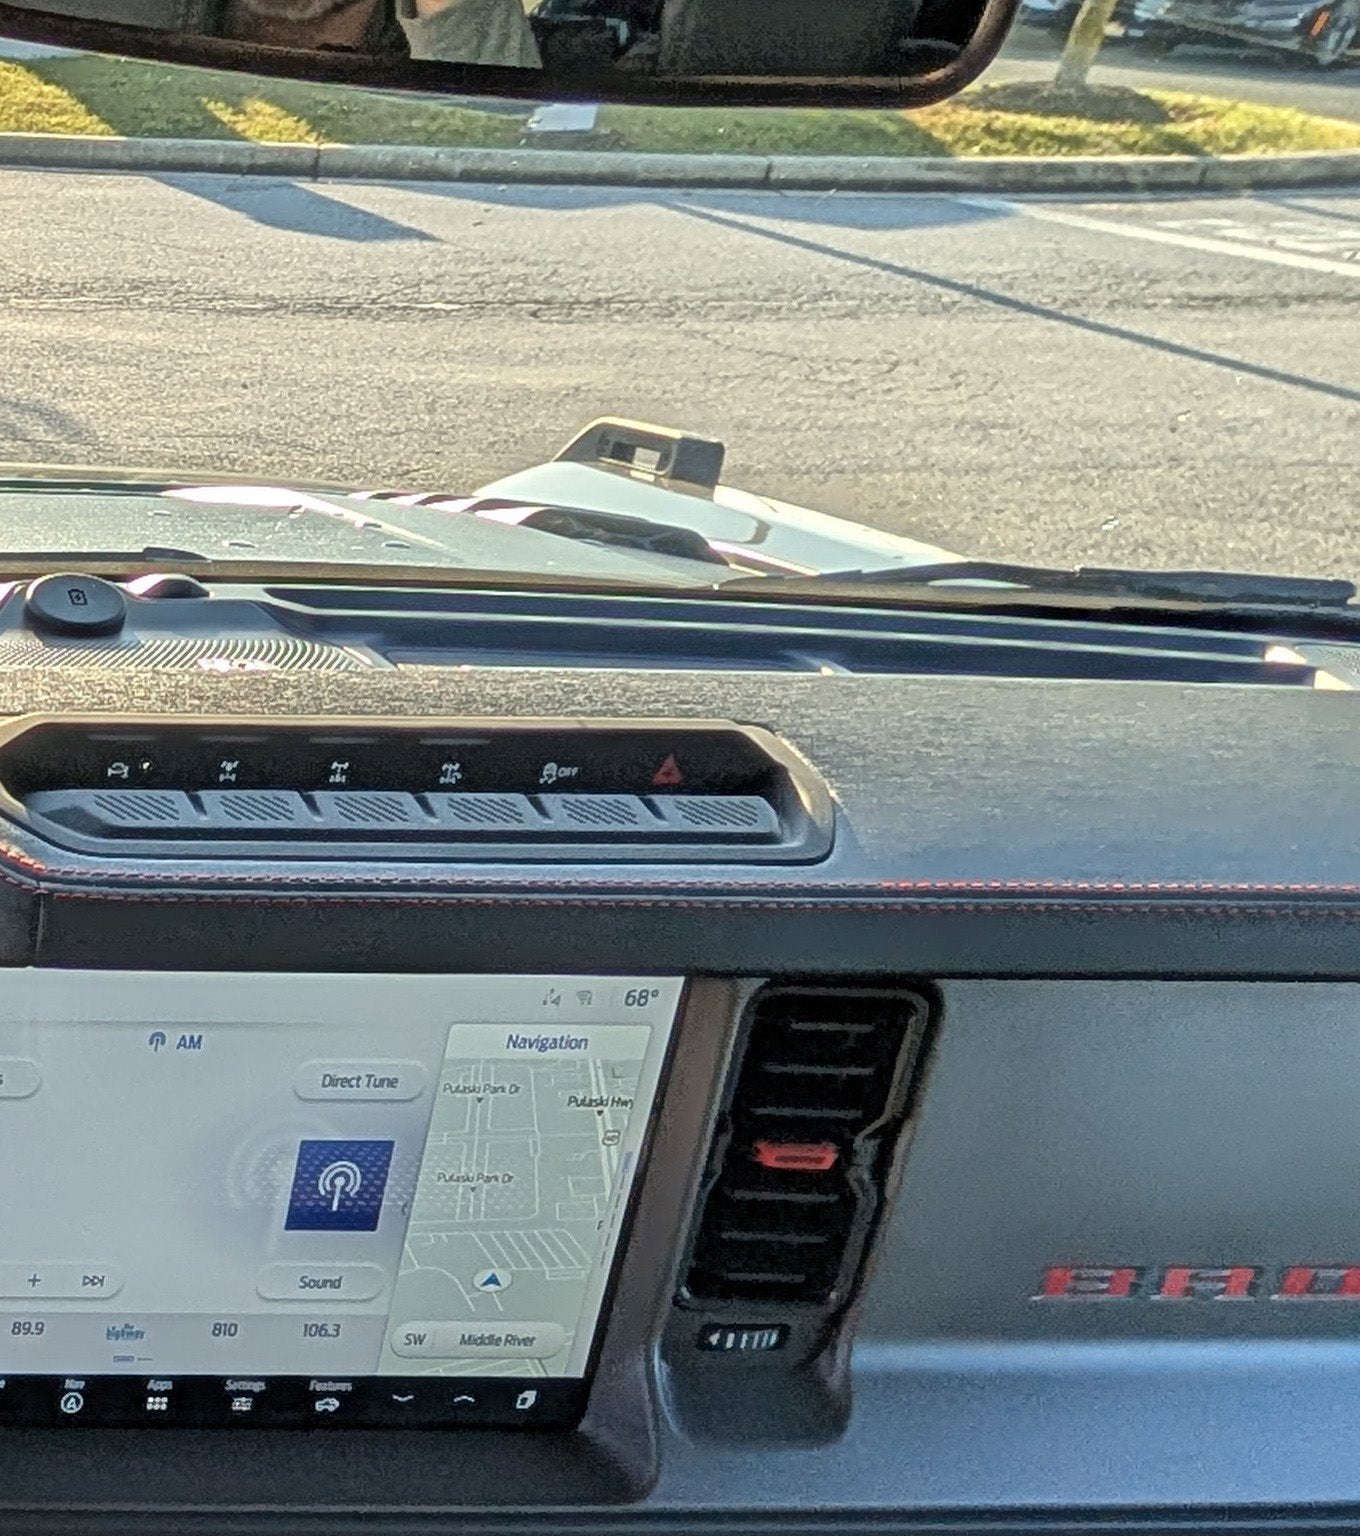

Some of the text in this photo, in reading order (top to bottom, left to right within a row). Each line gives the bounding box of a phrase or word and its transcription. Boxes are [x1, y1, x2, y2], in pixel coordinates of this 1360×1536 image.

[624, 988, 659, 1007] 68°
[176, 1034, 203, 1050] AM
[506, 1034, 588, 1052] Navigation
[321, 1074, 398, 1088] Direct Tune
[298, 1274, 343, 1289] Sound
[11, 1321, 45, 1336] 89.9
[211, 1322, 239, 1337] 810
[303, 1323, 341, 1338] 106.3
[403, 1333, 428, 1346] SW
[459, 1333, 536, 1347] Middle River
[147, 1379, 173, 1391] Apps
[225, 1379, 267, 1392] Settings
[308, 1380, 353, 1392] Features
